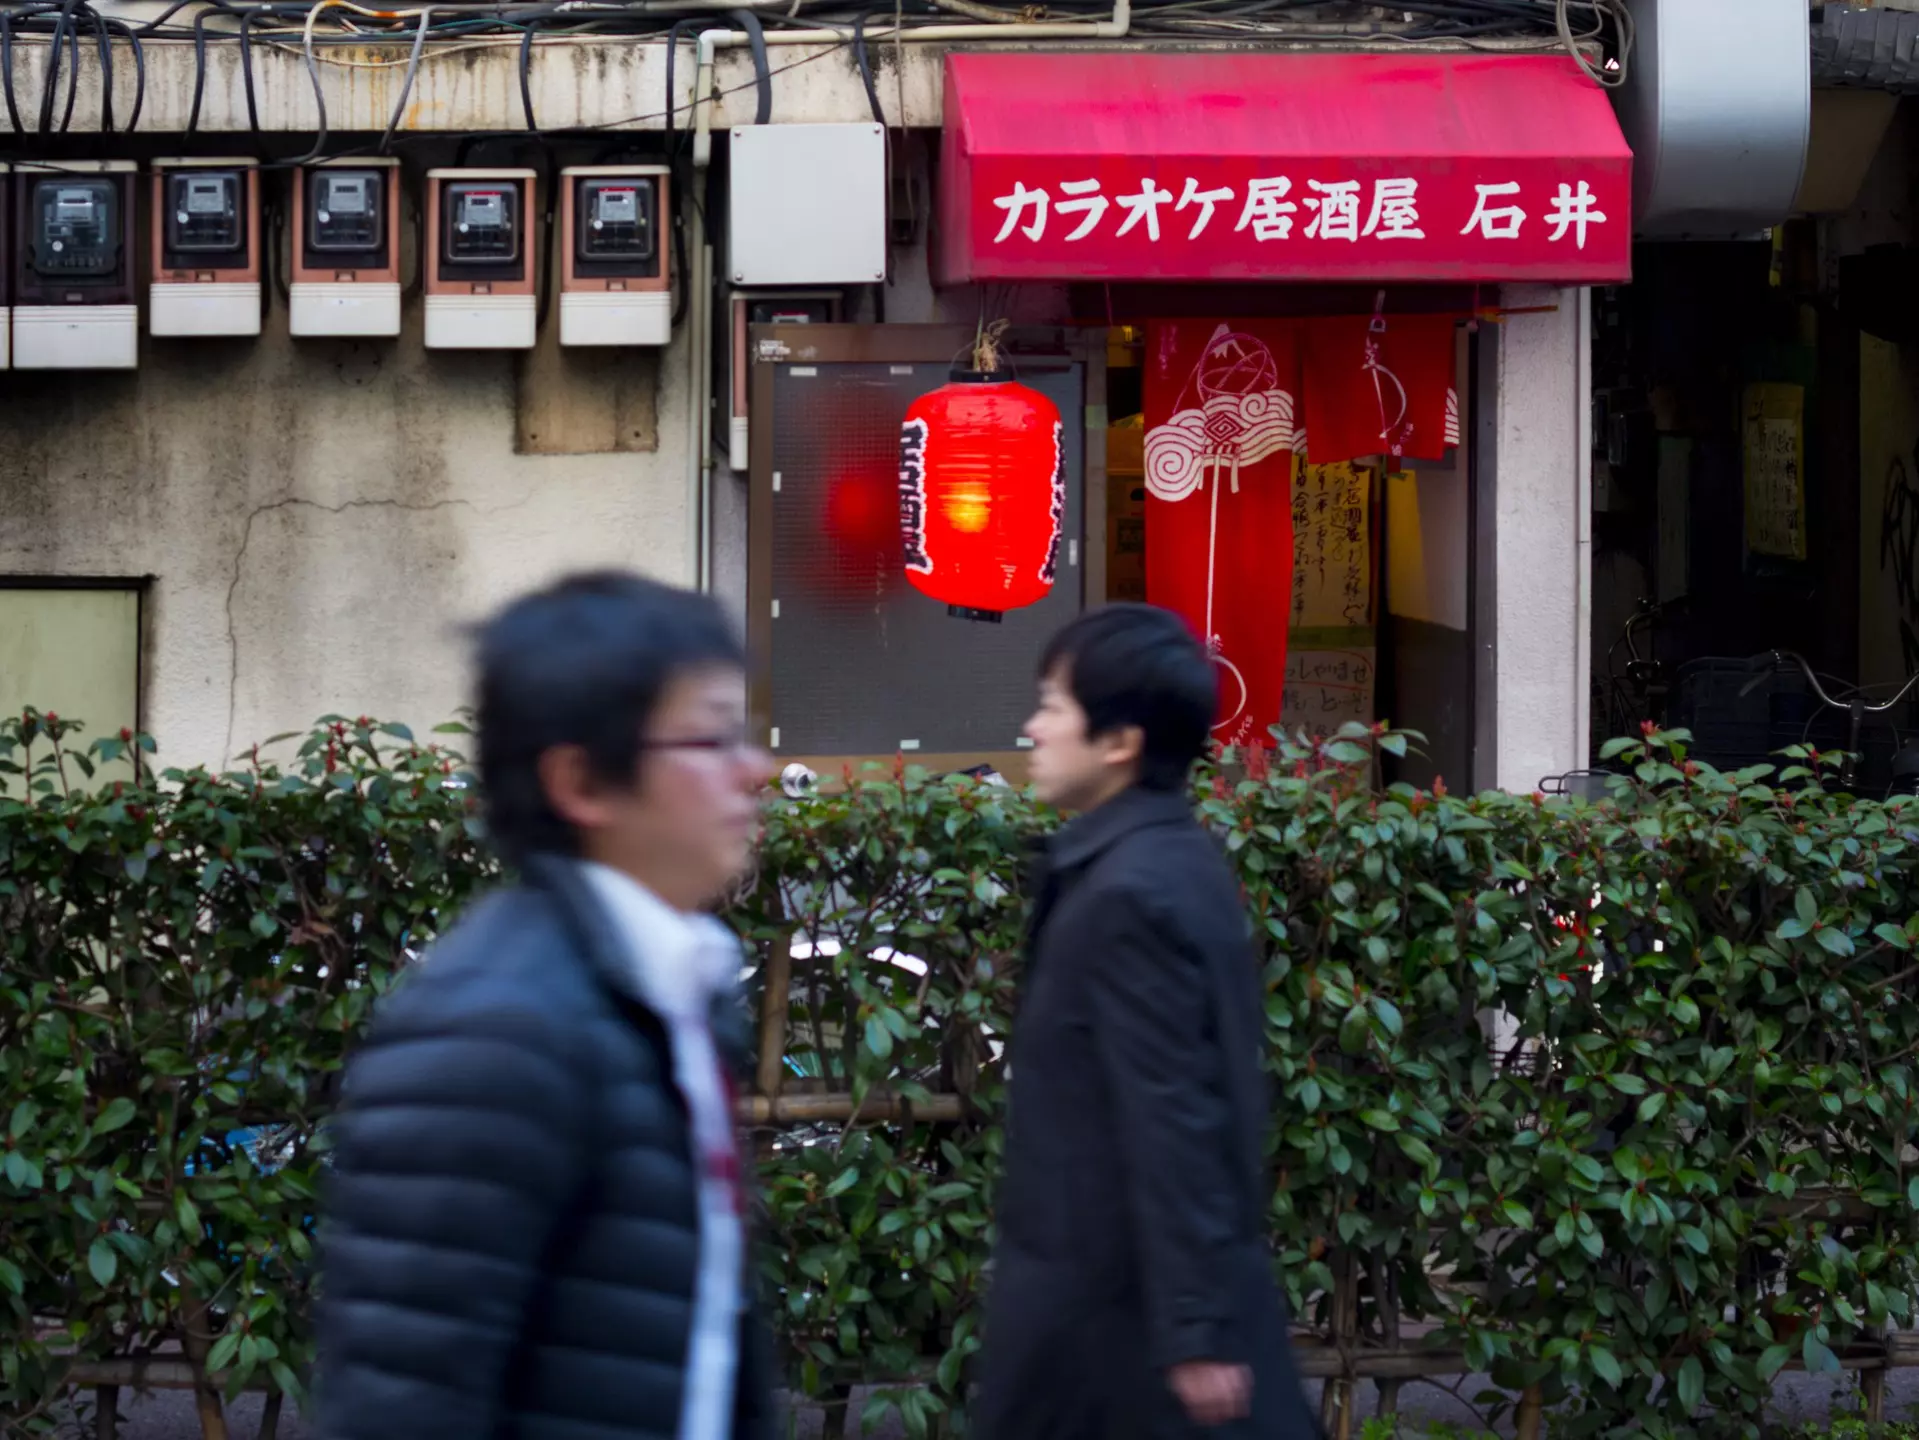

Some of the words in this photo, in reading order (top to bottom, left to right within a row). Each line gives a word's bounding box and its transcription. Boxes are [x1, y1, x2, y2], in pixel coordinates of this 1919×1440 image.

[993, 175, 1427, 243] カラオケ居酒屋
[1459, 180, 1608, 250] 石井
